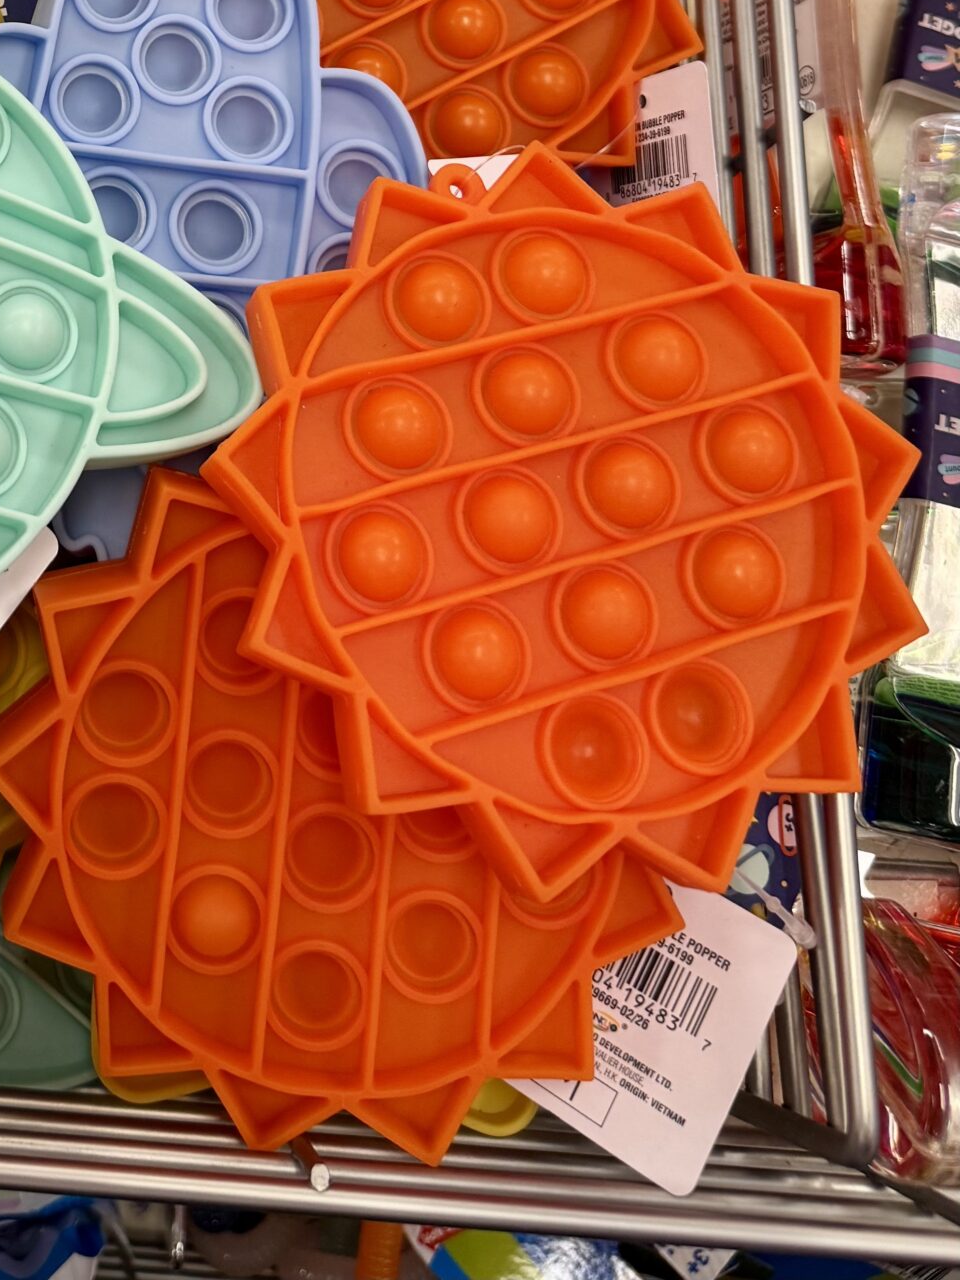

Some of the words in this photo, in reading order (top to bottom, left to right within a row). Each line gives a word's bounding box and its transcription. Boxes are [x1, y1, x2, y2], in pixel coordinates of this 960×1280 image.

[642, 116, 662, 130] BUBBLE
[663, 110, 685, 124] POPPER
[652, 174, 681, 191] 19483
[688, 938, 731, 972] POPPER
[591, 985, 650, 1030] 9669-02/26
[624, 987, 680, 1032] 19483
[599, 1034, 655, 1078] DEVELOPMENT
[655, 1072, 673, 1091] LTD.
[619, 1080, 650, 1103] ORIGIN:
[651, 1098, 687, 1127] VIETNAM
